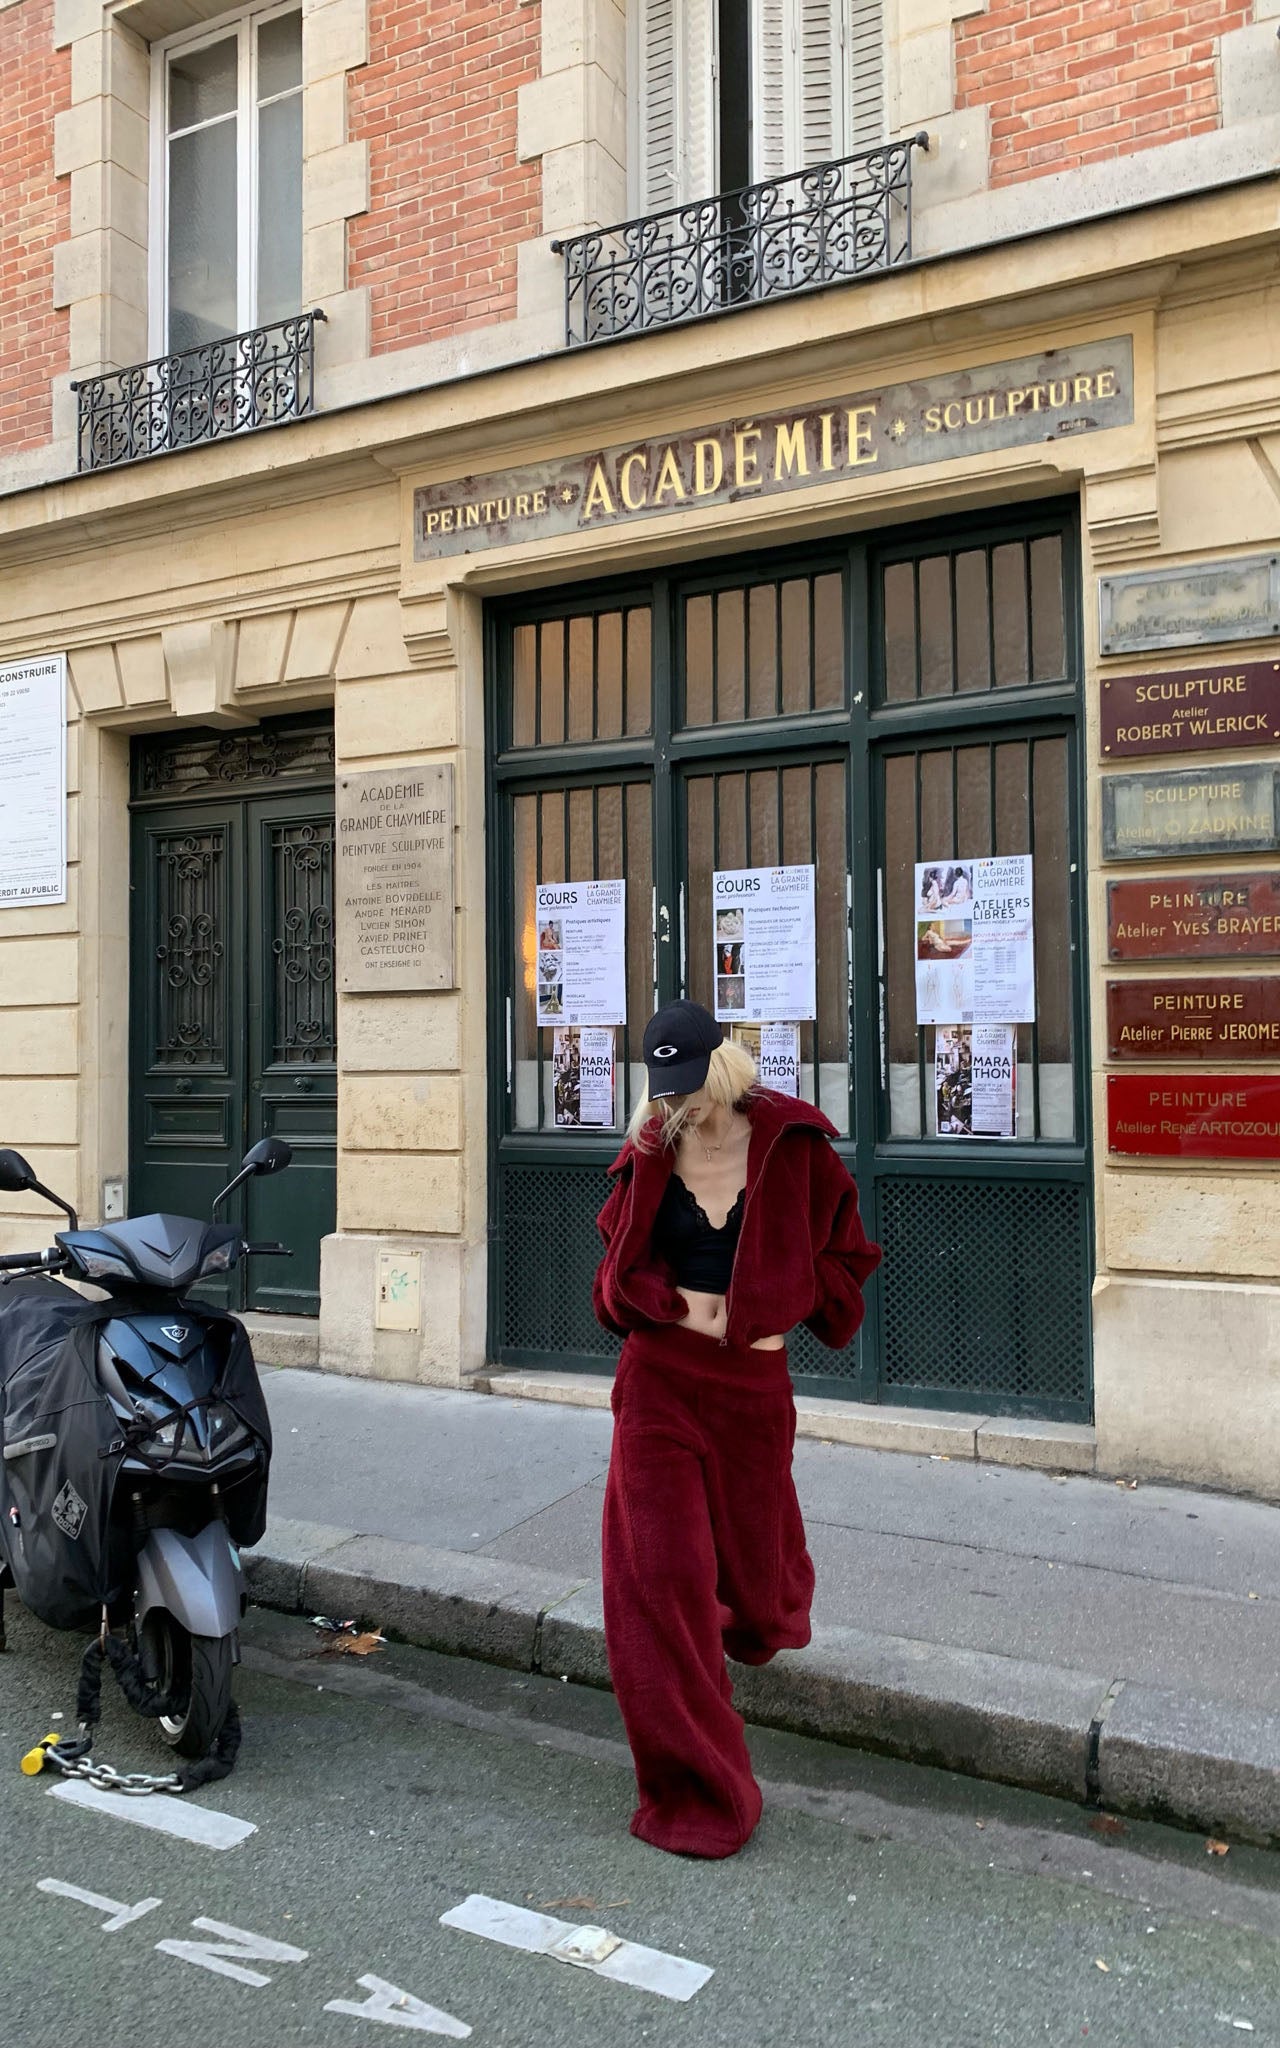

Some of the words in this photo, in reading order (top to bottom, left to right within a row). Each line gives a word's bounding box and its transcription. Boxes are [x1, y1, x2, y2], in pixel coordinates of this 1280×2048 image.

[425, 490, 547, 535] PEINTURE
[583, 404, 880, 520] ACADÉMIE
[924, 370, 1116, 434] SCULPTURE
[0, 665, 56, 683] CONSTRUIRE
[1136, 676, 1246, 702] SCULPTURE
[1172, 706, 1209, 719] Atelier
[1117, 722, 1184, 742] ROBERT
[1190, 714, 1268, 735] WLERICK
[360, 783, 425, 803] ACADÉMIE
[1144, 783, 1241, 804] SCULPTURE
[394, 802, 404, 810] LA
[340, 816, 383, 832] GRANDE
[1188, 814, 1271, 834] ZADKINE
[342, 842, 386, 856] PEINTVRE
[978, 868, 989, 877] LA
[991, 865, 1025, 876] GRANDE
[716, 878, 761, 893] COURS
[771, 876, 781, 884] LA
[781, 874, 810, 883] GRANDE
[20, 887, 30, 895] AU
[32, 885, 59, 893] PUBLIC
[367, 882, 382, 890] LES
[596, 888, 622, 897] GRANDE
[345, 897, 381, 906] ANTOINE
[386, 892, 442, 903] BOVRDELLE
[539, 891, 578, 906] COURS
[973, 897, 1030, 910] ATELIERS
[391, 905, 432, 916] MÉNARD
[973, 909, 1016, 920] LIBRES
[361, 922, 390, 930] LVCIEN
[395, 919, 425, 928] SIMON
[1116, 922, 1166, 938] Atelier
[1173, 920, 1210, 936] YVES
[1217, 916, 1280, 934] BRAYER
[357, 934, 388, 943] XAVIER
[393, 931, 427, 941] PRINET
[361, 944, 425, 955] CASTELUCHO
[1153, 995, 1244, 1010] PEINTURE
[1121, 1026, 1164, 1041] Atelier
[1171, 1025, 1213, 1040] PIERRE
[1219, 1024, 1280, 1040] JEROME
[581, 1057, 610, 1065] MARA
[762, 1056, 794, 1065] MARA
[974, 1057, 1010, 1067] MARA
[581, 1067, 610, 1076] THON
[762, 1067, 794, 1076] THON
[974, 1069, 1010, 1079] THON
[1149, 1093, 1247, 1107] PEINTURE
[1116, 1120, 1157, 1134] Atelier
[1161, 1119, 1197, 1135] RENÉ
